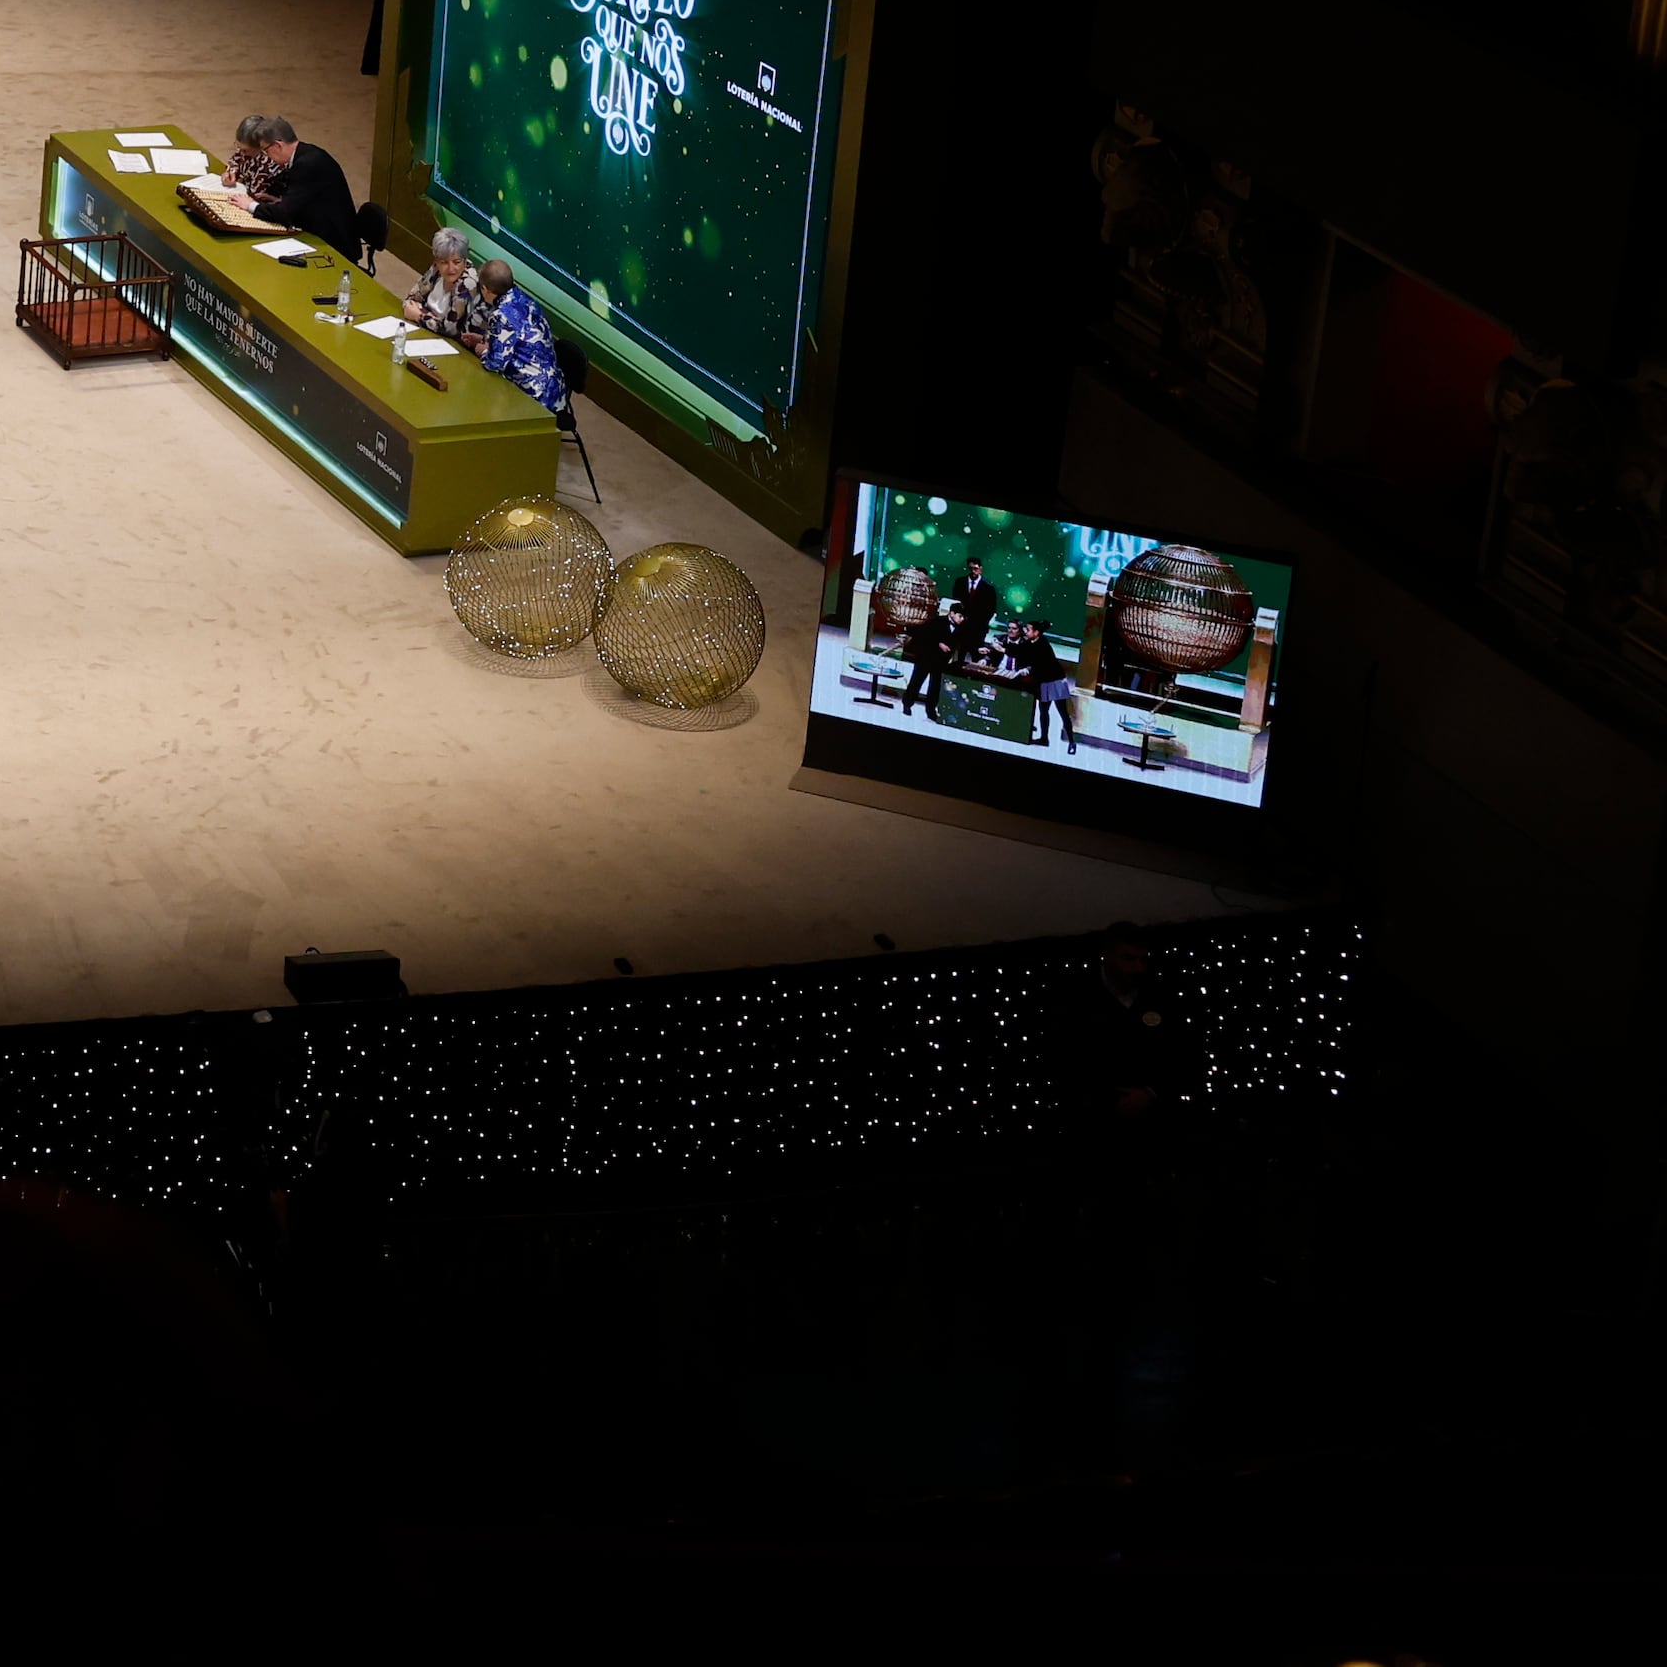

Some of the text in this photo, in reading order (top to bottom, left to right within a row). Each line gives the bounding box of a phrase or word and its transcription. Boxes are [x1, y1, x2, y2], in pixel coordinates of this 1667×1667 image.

[595, 4, 685, 96] QUE NOS
[580, 36, 659, 157] UNE
[727, 80, 802, 133] LOTERÍA NACIONAL
[184, 273, 278, 359] NO HAY MAYOR SUERTE
[185, 293, 274, 374] QUE LA DE TENERNOS
